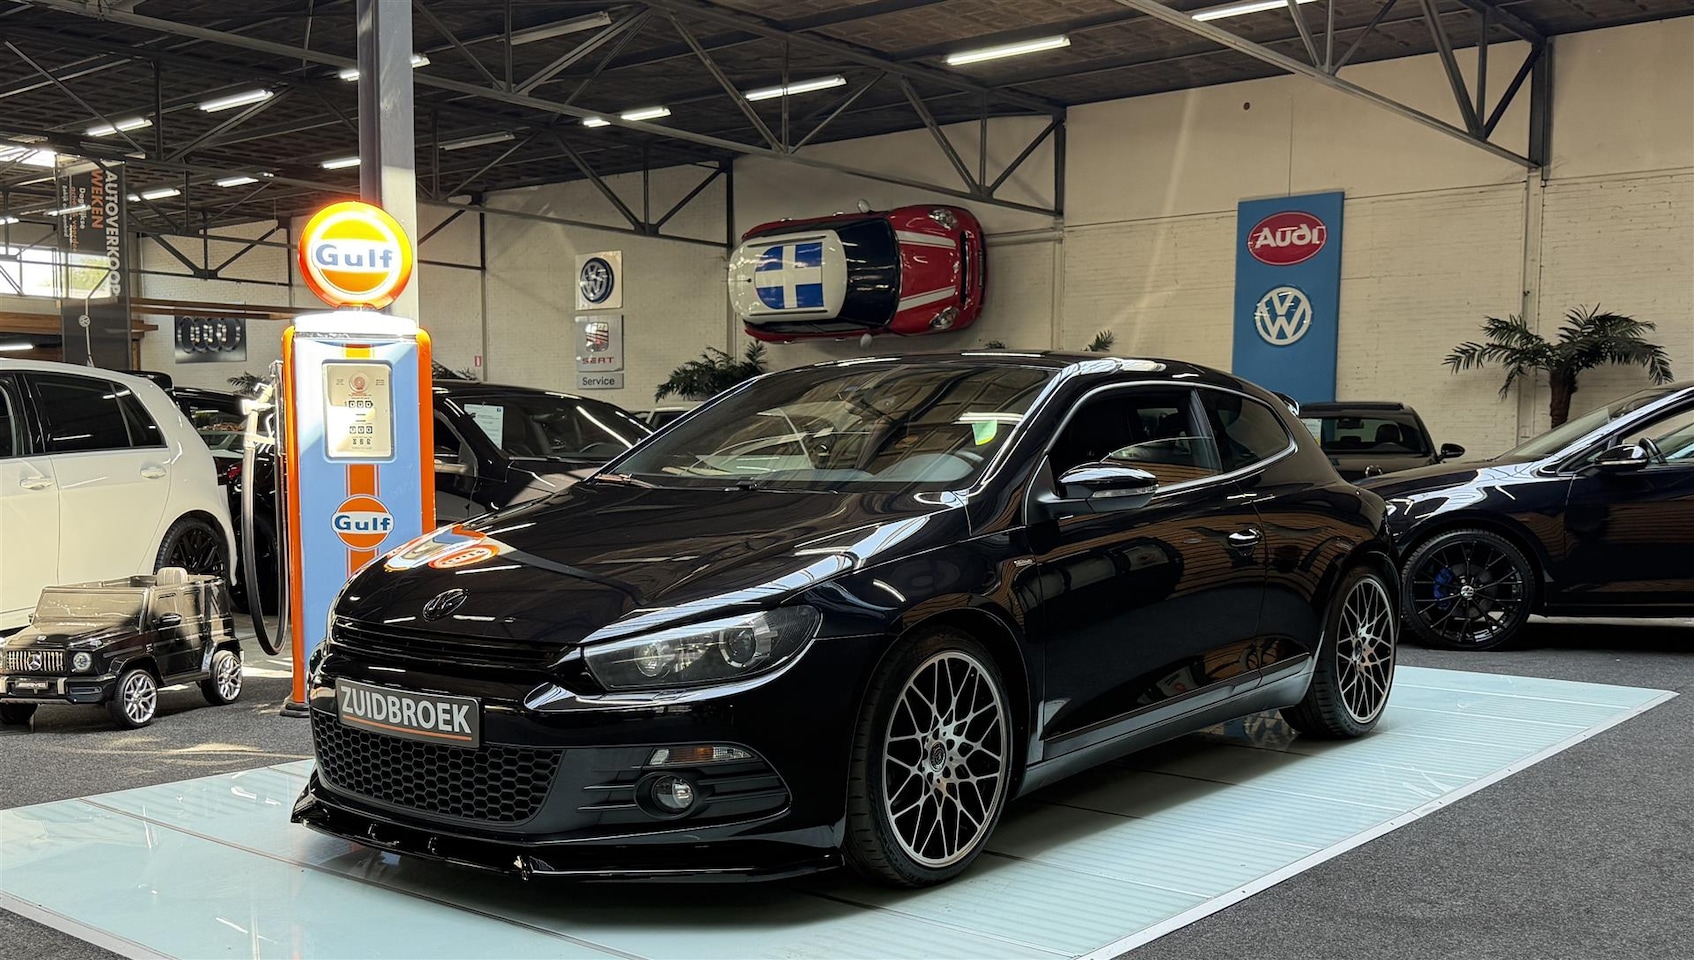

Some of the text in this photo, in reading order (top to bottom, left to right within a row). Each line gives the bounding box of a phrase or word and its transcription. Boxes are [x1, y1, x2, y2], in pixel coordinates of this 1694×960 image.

[91, 169, 104, 230] WEKEN
[105, 171, 121, 296] AUTOVERKOOP
[316, 244, 393, 268] Gulf
[582, 356, 614, 365] SEAT
[582, 376, 615, 386] Service
[334, 515, 391, 531] Gulf
[340, 686, 472, 733] ZUIDBROEK
